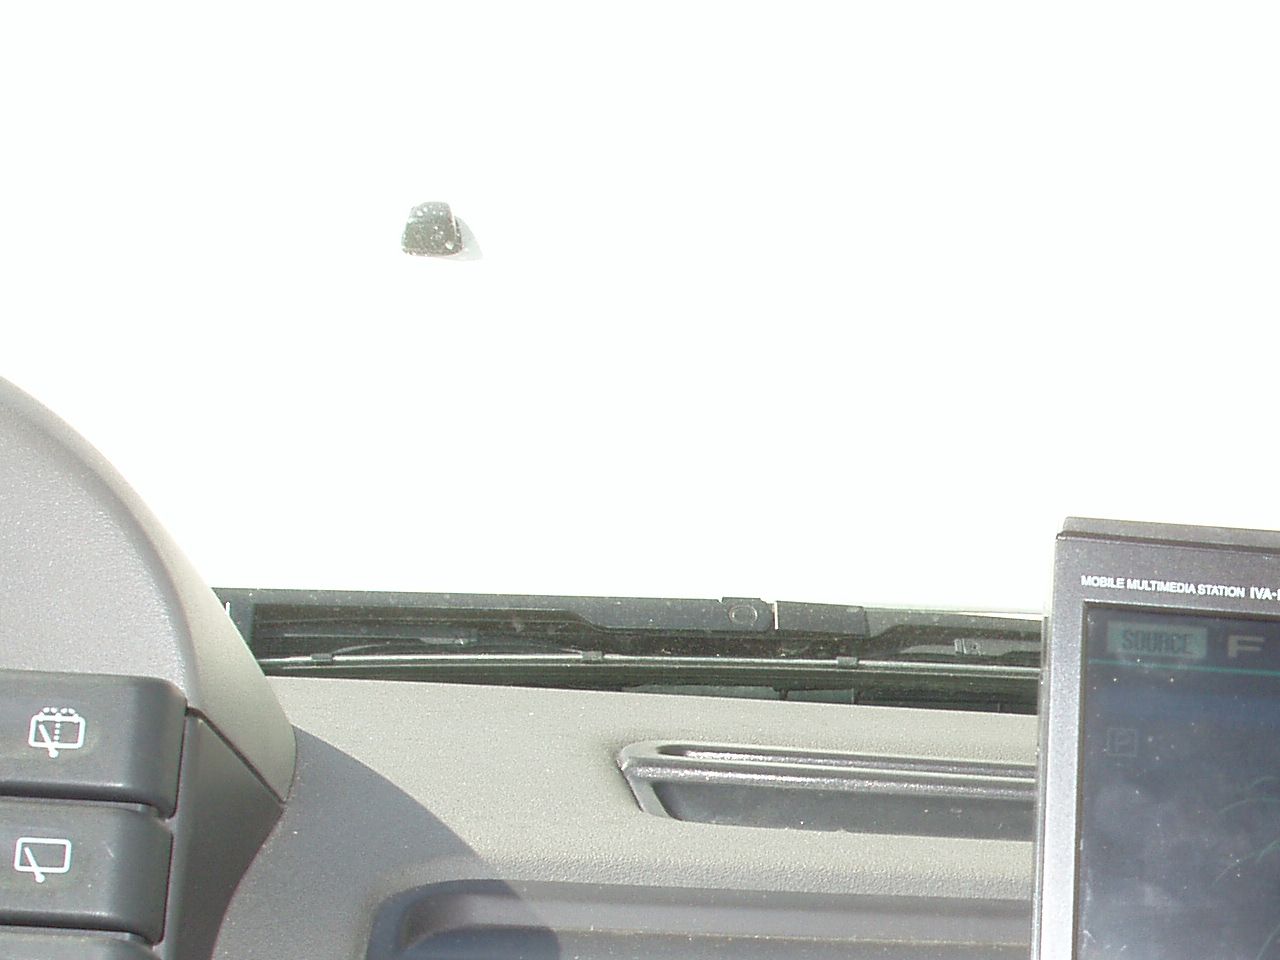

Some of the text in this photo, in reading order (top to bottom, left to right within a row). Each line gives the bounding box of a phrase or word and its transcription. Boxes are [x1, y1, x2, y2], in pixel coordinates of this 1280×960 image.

[1081, 576, 1125, 589] MOBILE
[1126, 579, 1196, 594] MULTIMEDIA
[1198, 584, 1246, 598] STATION
[1121, 628, 1195, 654] SOURCE
